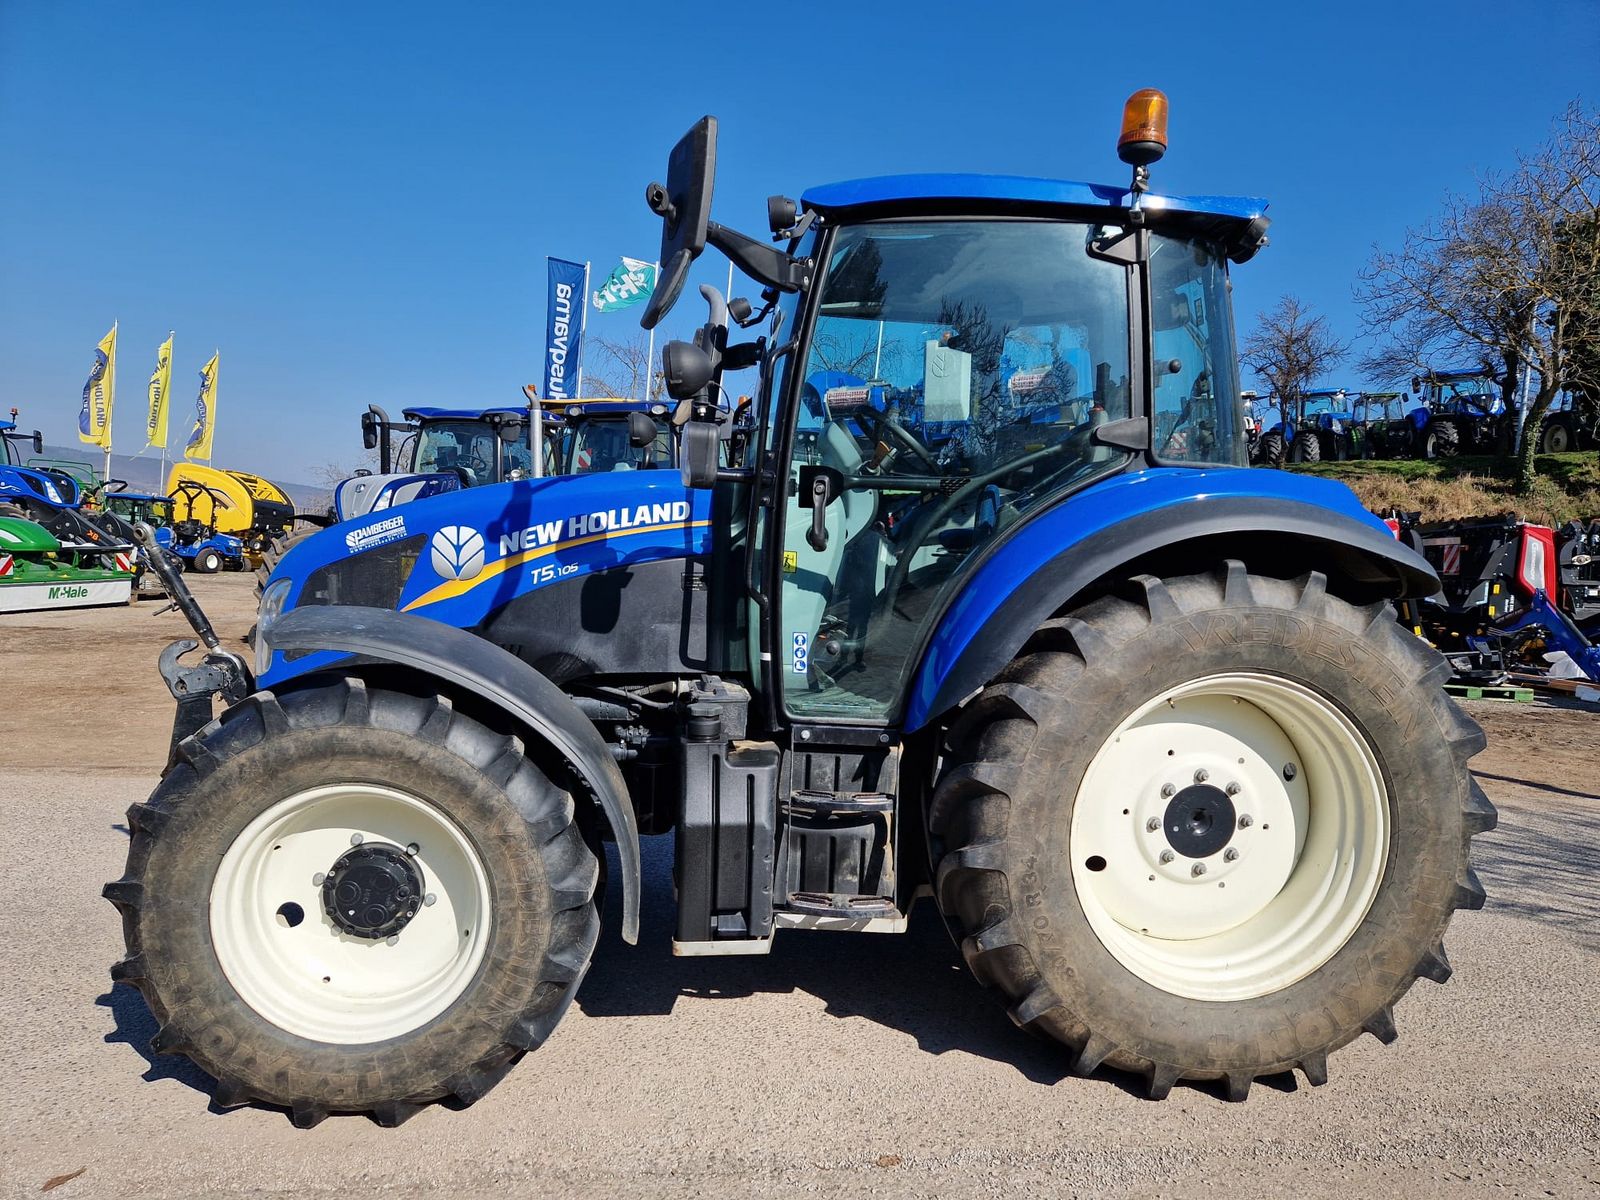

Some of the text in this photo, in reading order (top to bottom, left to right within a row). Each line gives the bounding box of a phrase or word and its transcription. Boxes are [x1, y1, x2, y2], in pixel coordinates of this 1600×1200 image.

[94, 383, 105, 428] HOLLAND
[354, 515, 404, 545] PAMBERGER
[499, 501, 691, 557] NEW HOLLAND
[530, 562, 579, 585] T5.105
